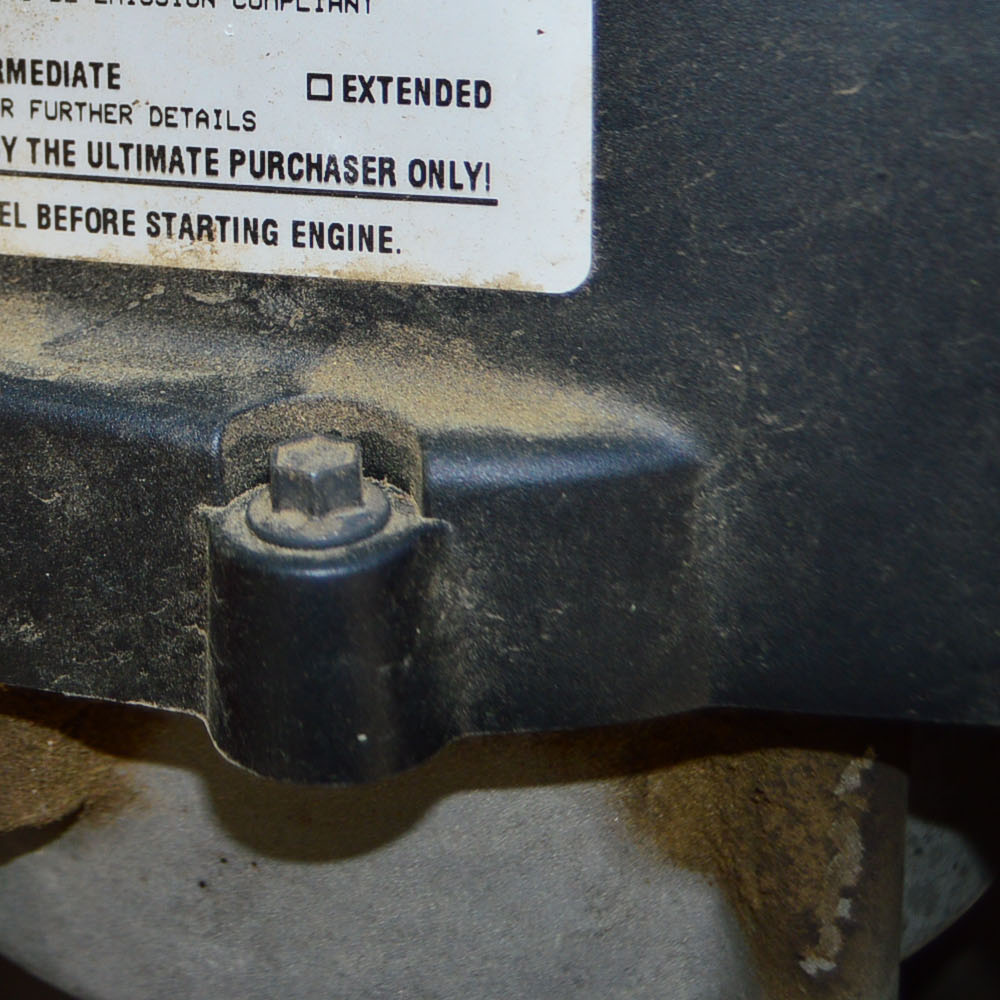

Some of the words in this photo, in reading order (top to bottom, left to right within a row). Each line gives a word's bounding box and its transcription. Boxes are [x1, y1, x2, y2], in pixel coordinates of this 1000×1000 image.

[342, 73, 492, 109] EXTENDED
[31, 100, 134, 124] FURTHER
[149, 105, 257, 133] DETAILS
[25, 136, 76, 168] THE
[87, 140, 219, 178] ULTIMATE
[229, 148, 397, 188] PURCHASER
[408, 158, 491, 193] ONLY!
[36, 203, 136, 237] BEFORE
[145, 210, 279, 247] STARTING
[291, 219, 401, 255] ENGINE.
